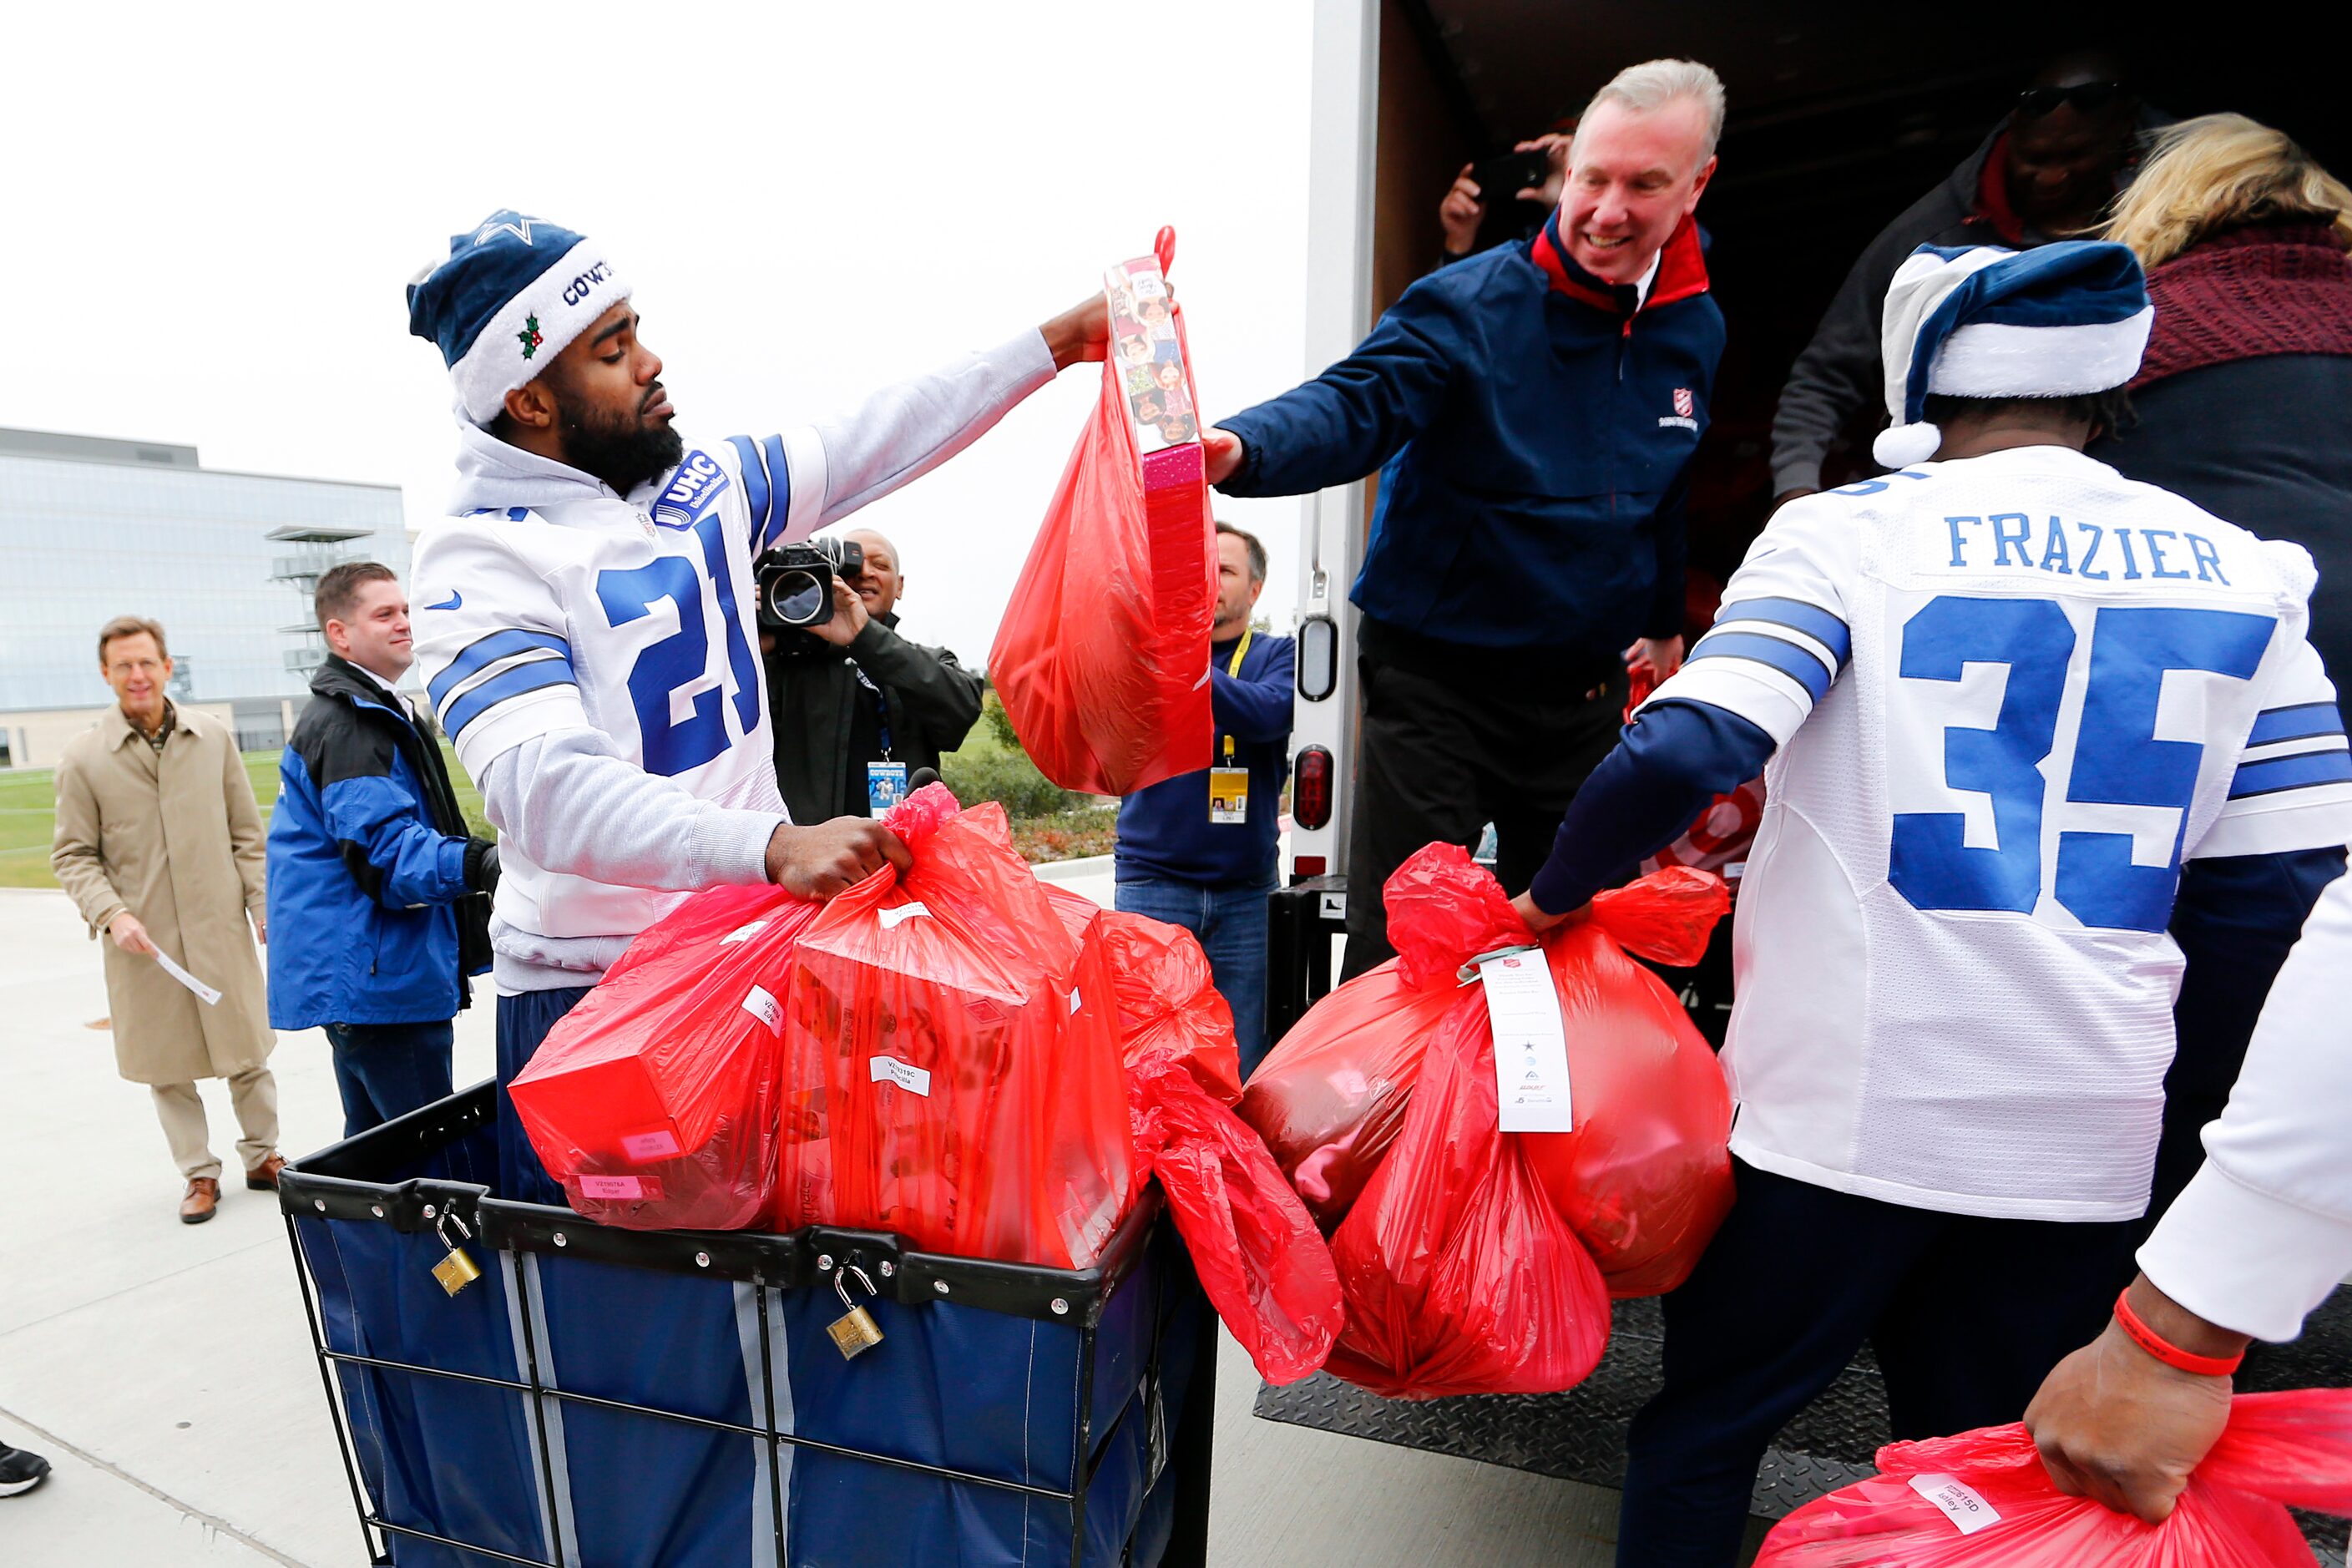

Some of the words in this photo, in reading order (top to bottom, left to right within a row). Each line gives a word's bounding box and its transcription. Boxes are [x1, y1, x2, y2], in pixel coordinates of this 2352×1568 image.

[665, 455, 716, 503] UHC
[1944, 513, 2232, 587] FRAZIER
[596, 513, 761, 777] 21
[1887, 594, 2279, 934] 35
